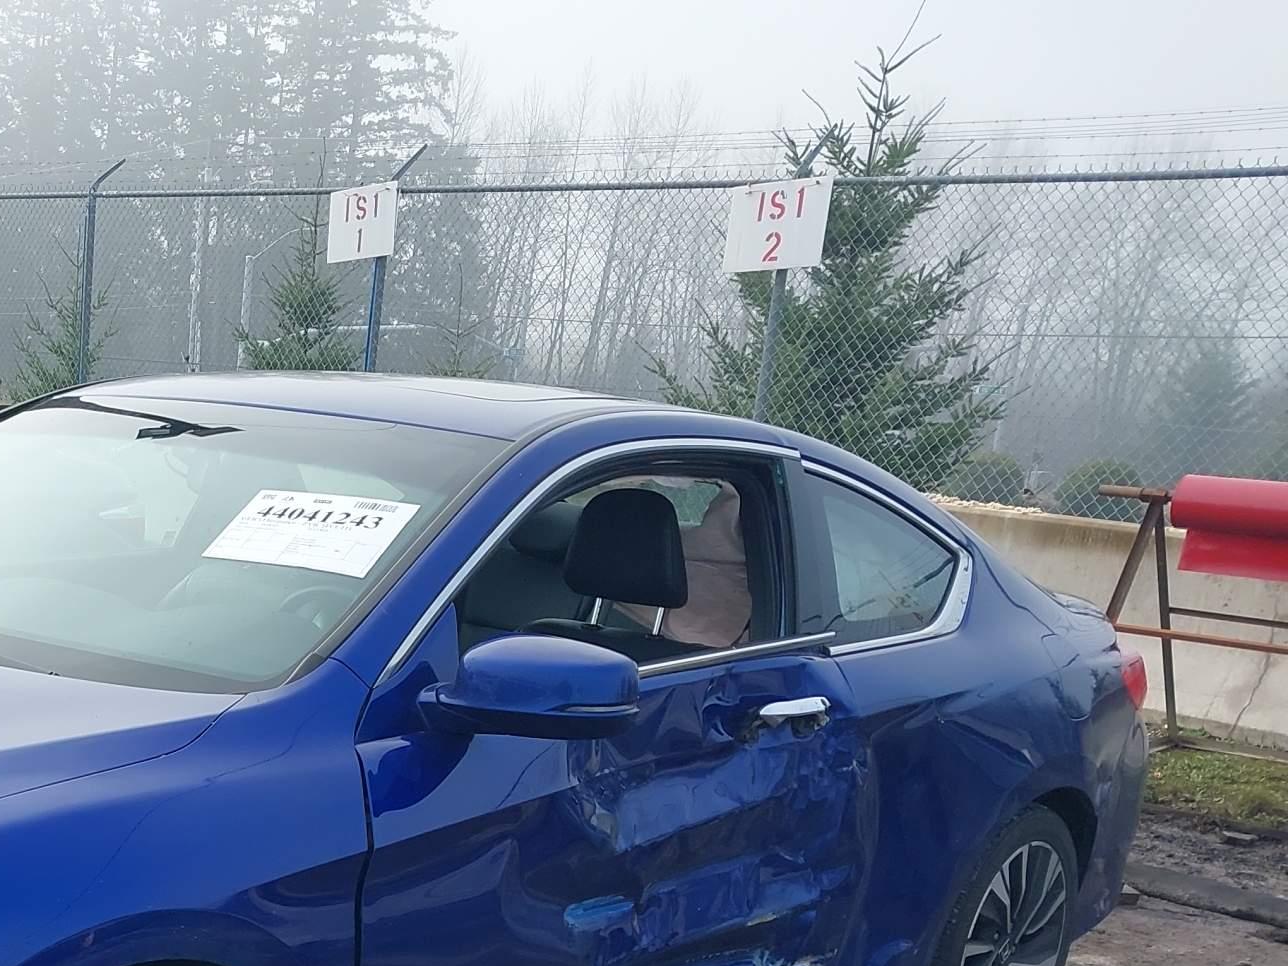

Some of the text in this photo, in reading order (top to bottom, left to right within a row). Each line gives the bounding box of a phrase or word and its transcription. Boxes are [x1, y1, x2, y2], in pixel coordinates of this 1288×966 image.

[356, 228, 363, 253] 1
[761, 231, 782, 262] 2
[257, 505, 384, 529] 44041243
